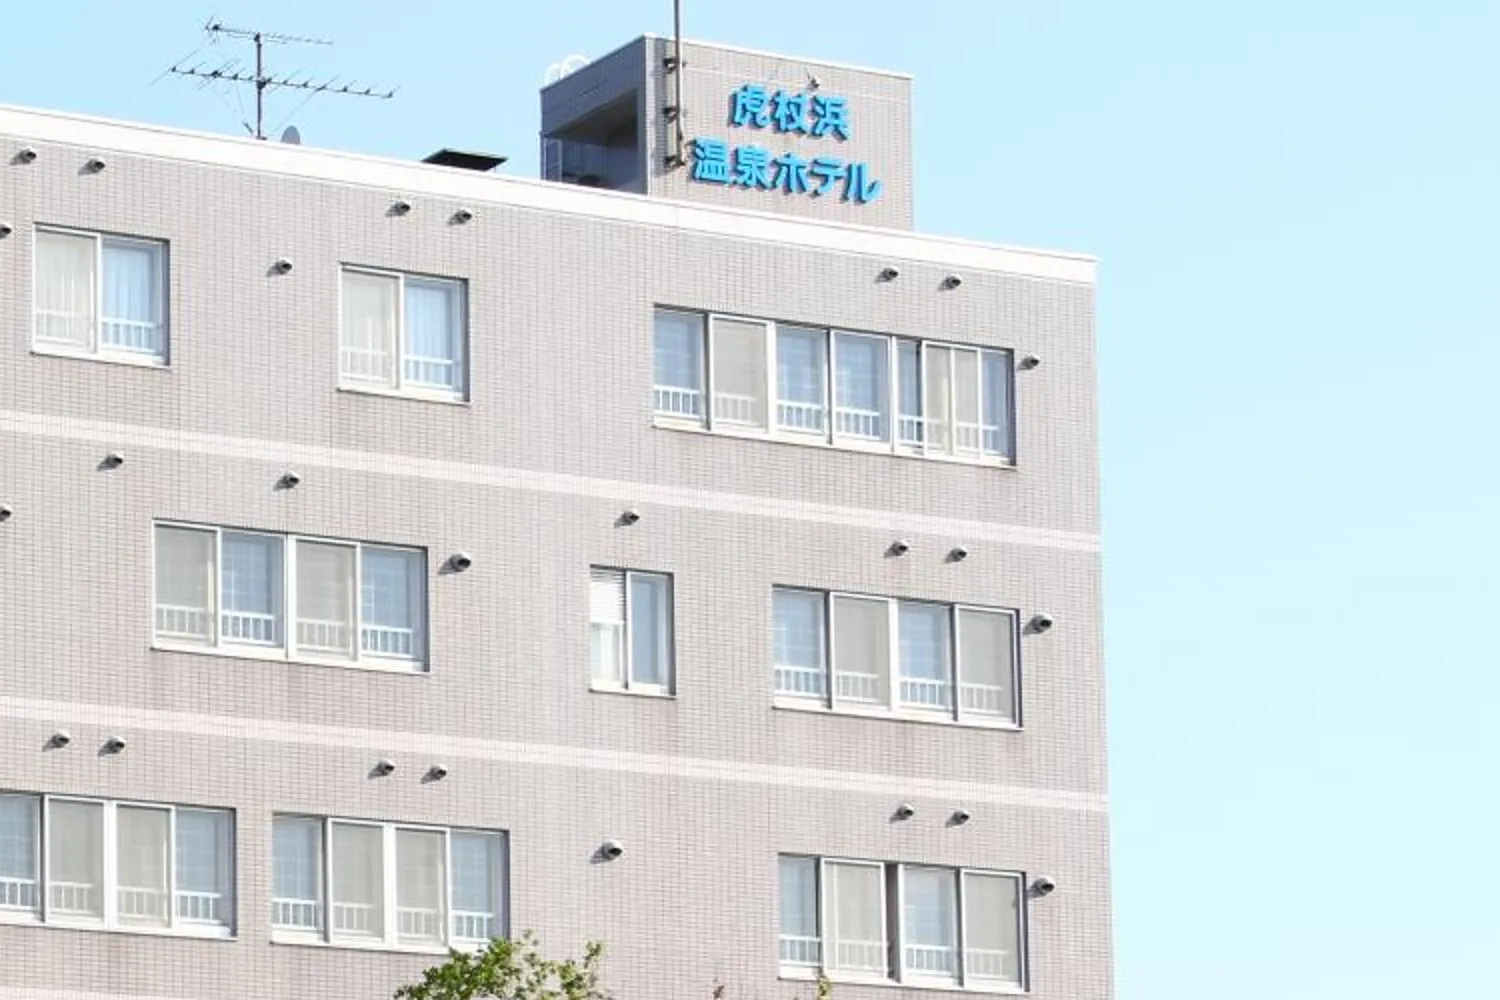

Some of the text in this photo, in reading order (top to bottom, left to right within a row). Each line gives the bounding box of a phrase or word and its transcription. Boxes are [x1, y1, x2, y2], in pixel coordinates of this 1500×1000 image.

[732, 83, 849, 140] 虎杖浜
[692, 138, 881, 203] 温泉ホテル
